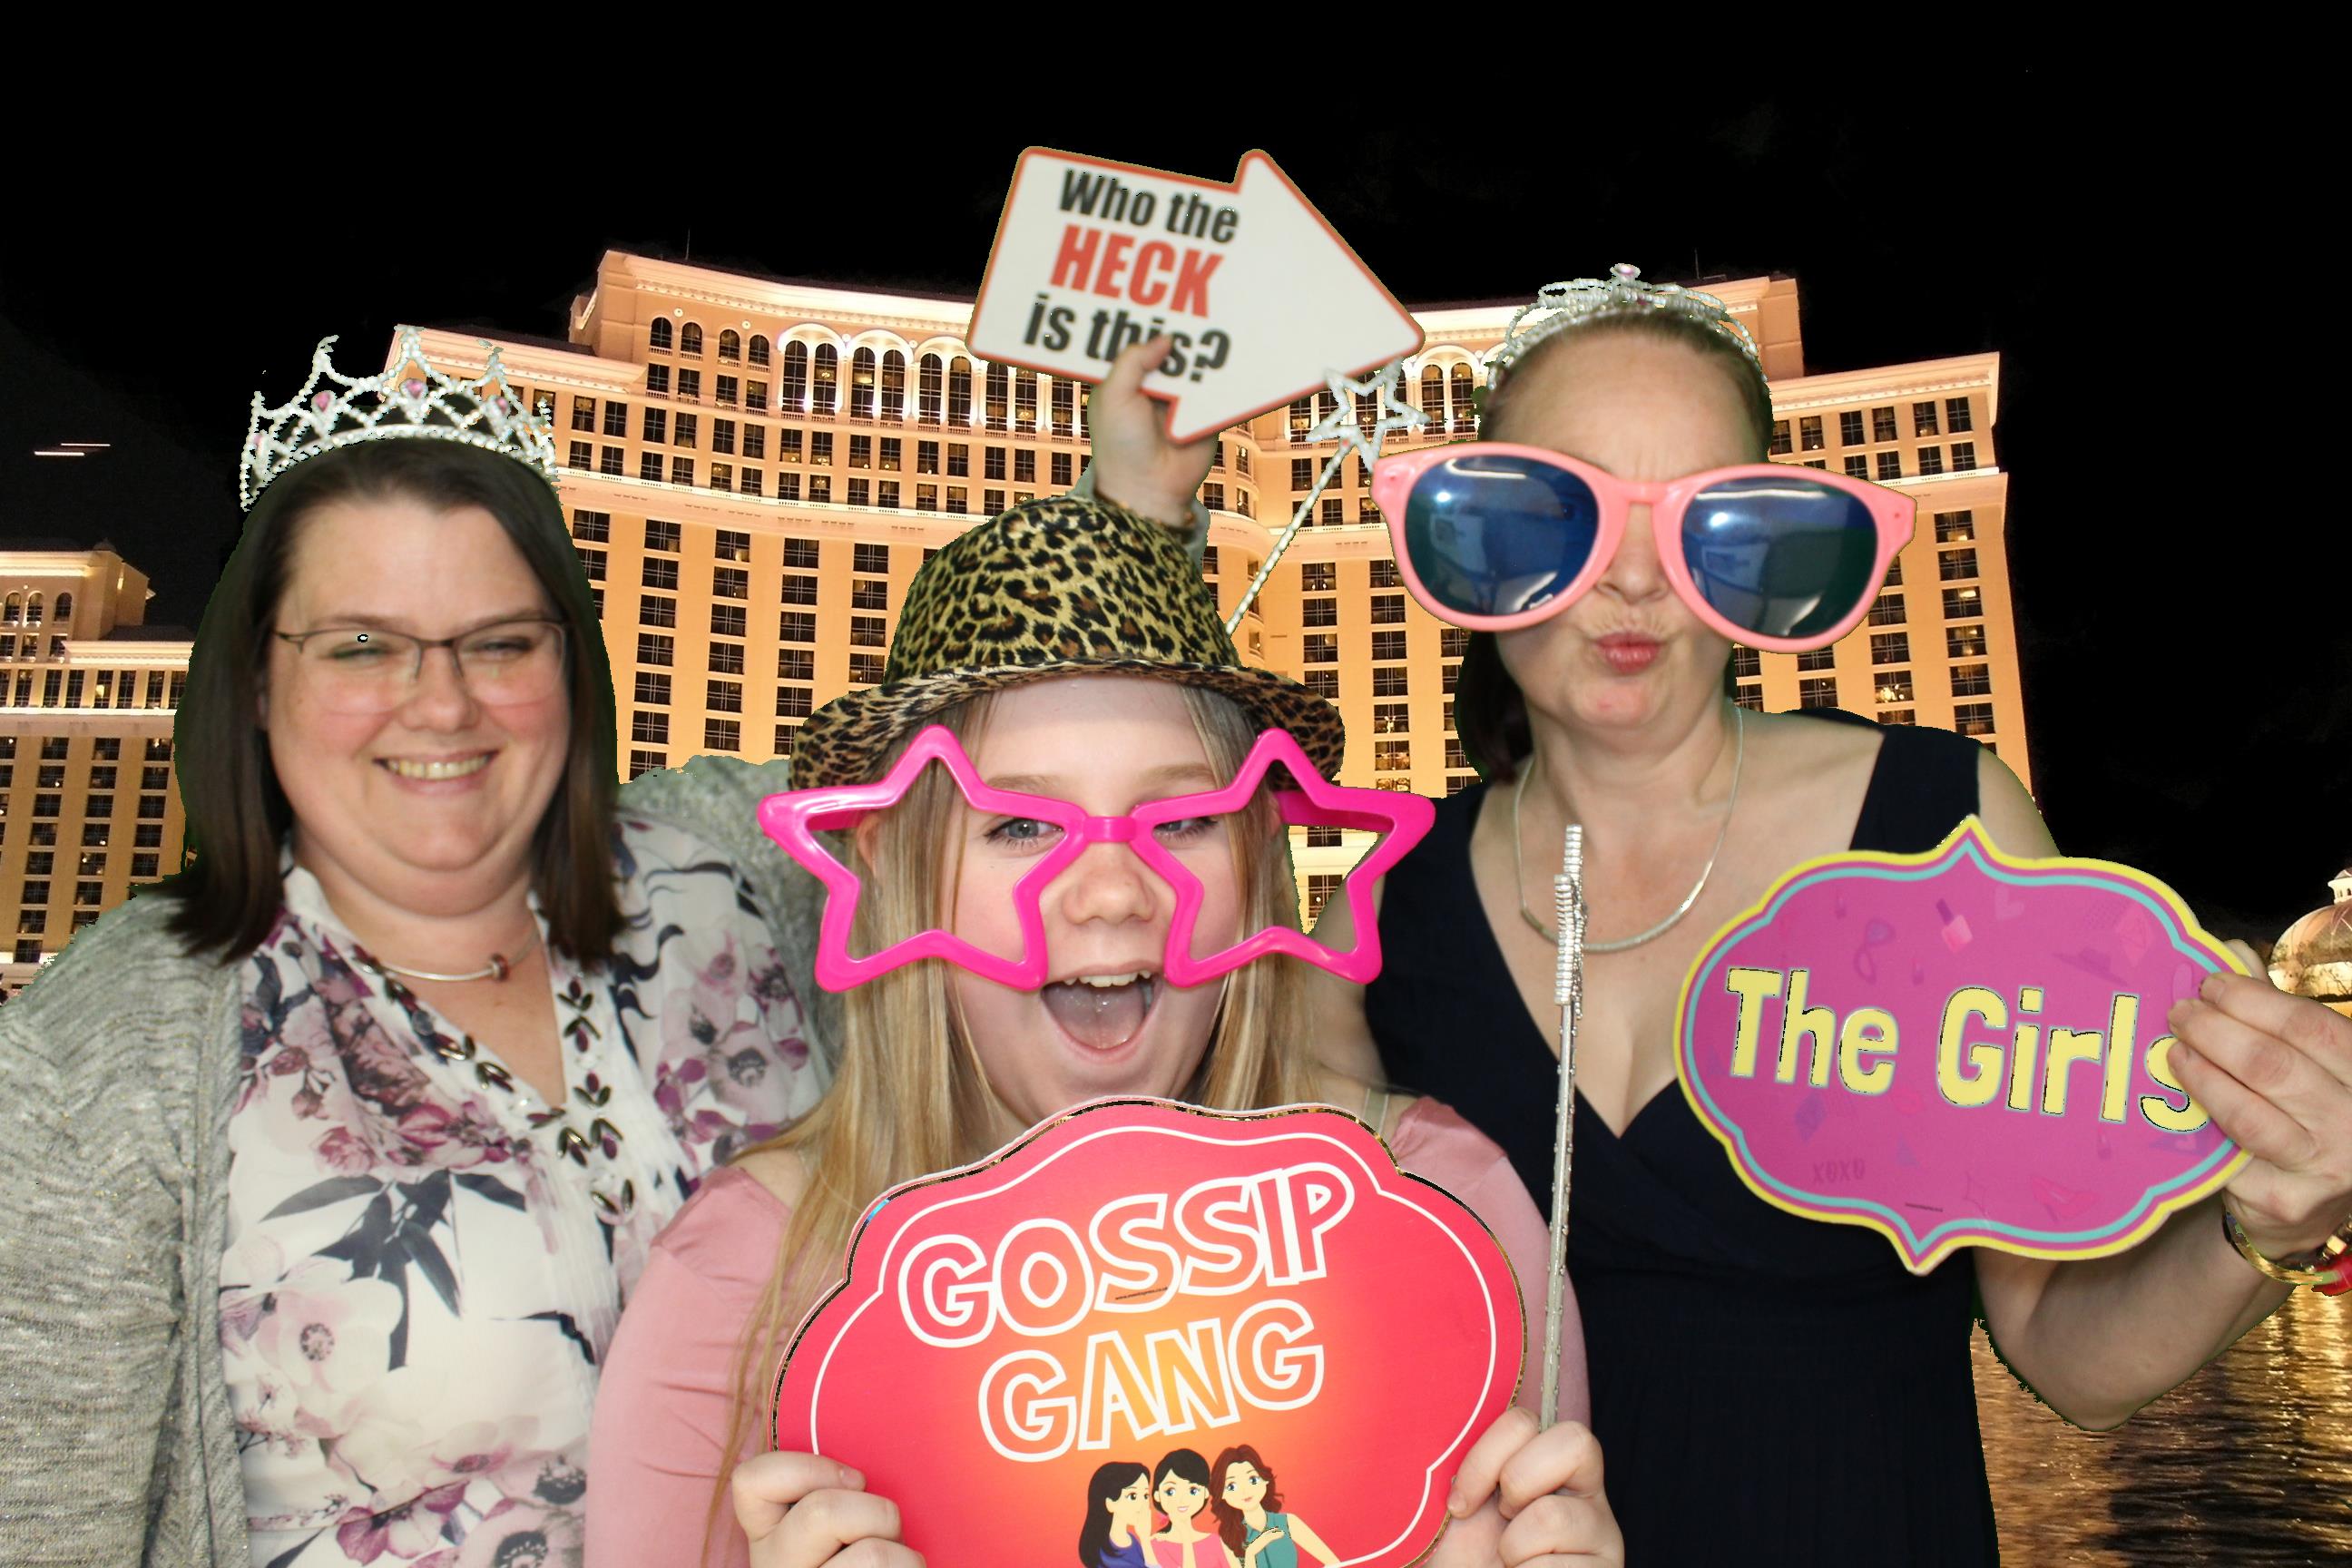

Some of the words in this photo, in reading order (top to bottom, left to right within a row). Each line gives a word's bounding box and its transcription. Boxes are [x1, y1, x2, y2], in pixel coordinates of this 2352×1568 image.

[1058, 167, 1156, 227] Who
[1166, 191, 1240, 243] the
[1023, 292, 1076, 352] is
[1049, 224, 1224, 318] HECK
[1725, 967, 1899, 1095] The
[1937, 986, 2210, 1133] Girls
[897, 1161, 1356, 1348] GOSSIP
[978, 1298, 1324, 1462] GANG
